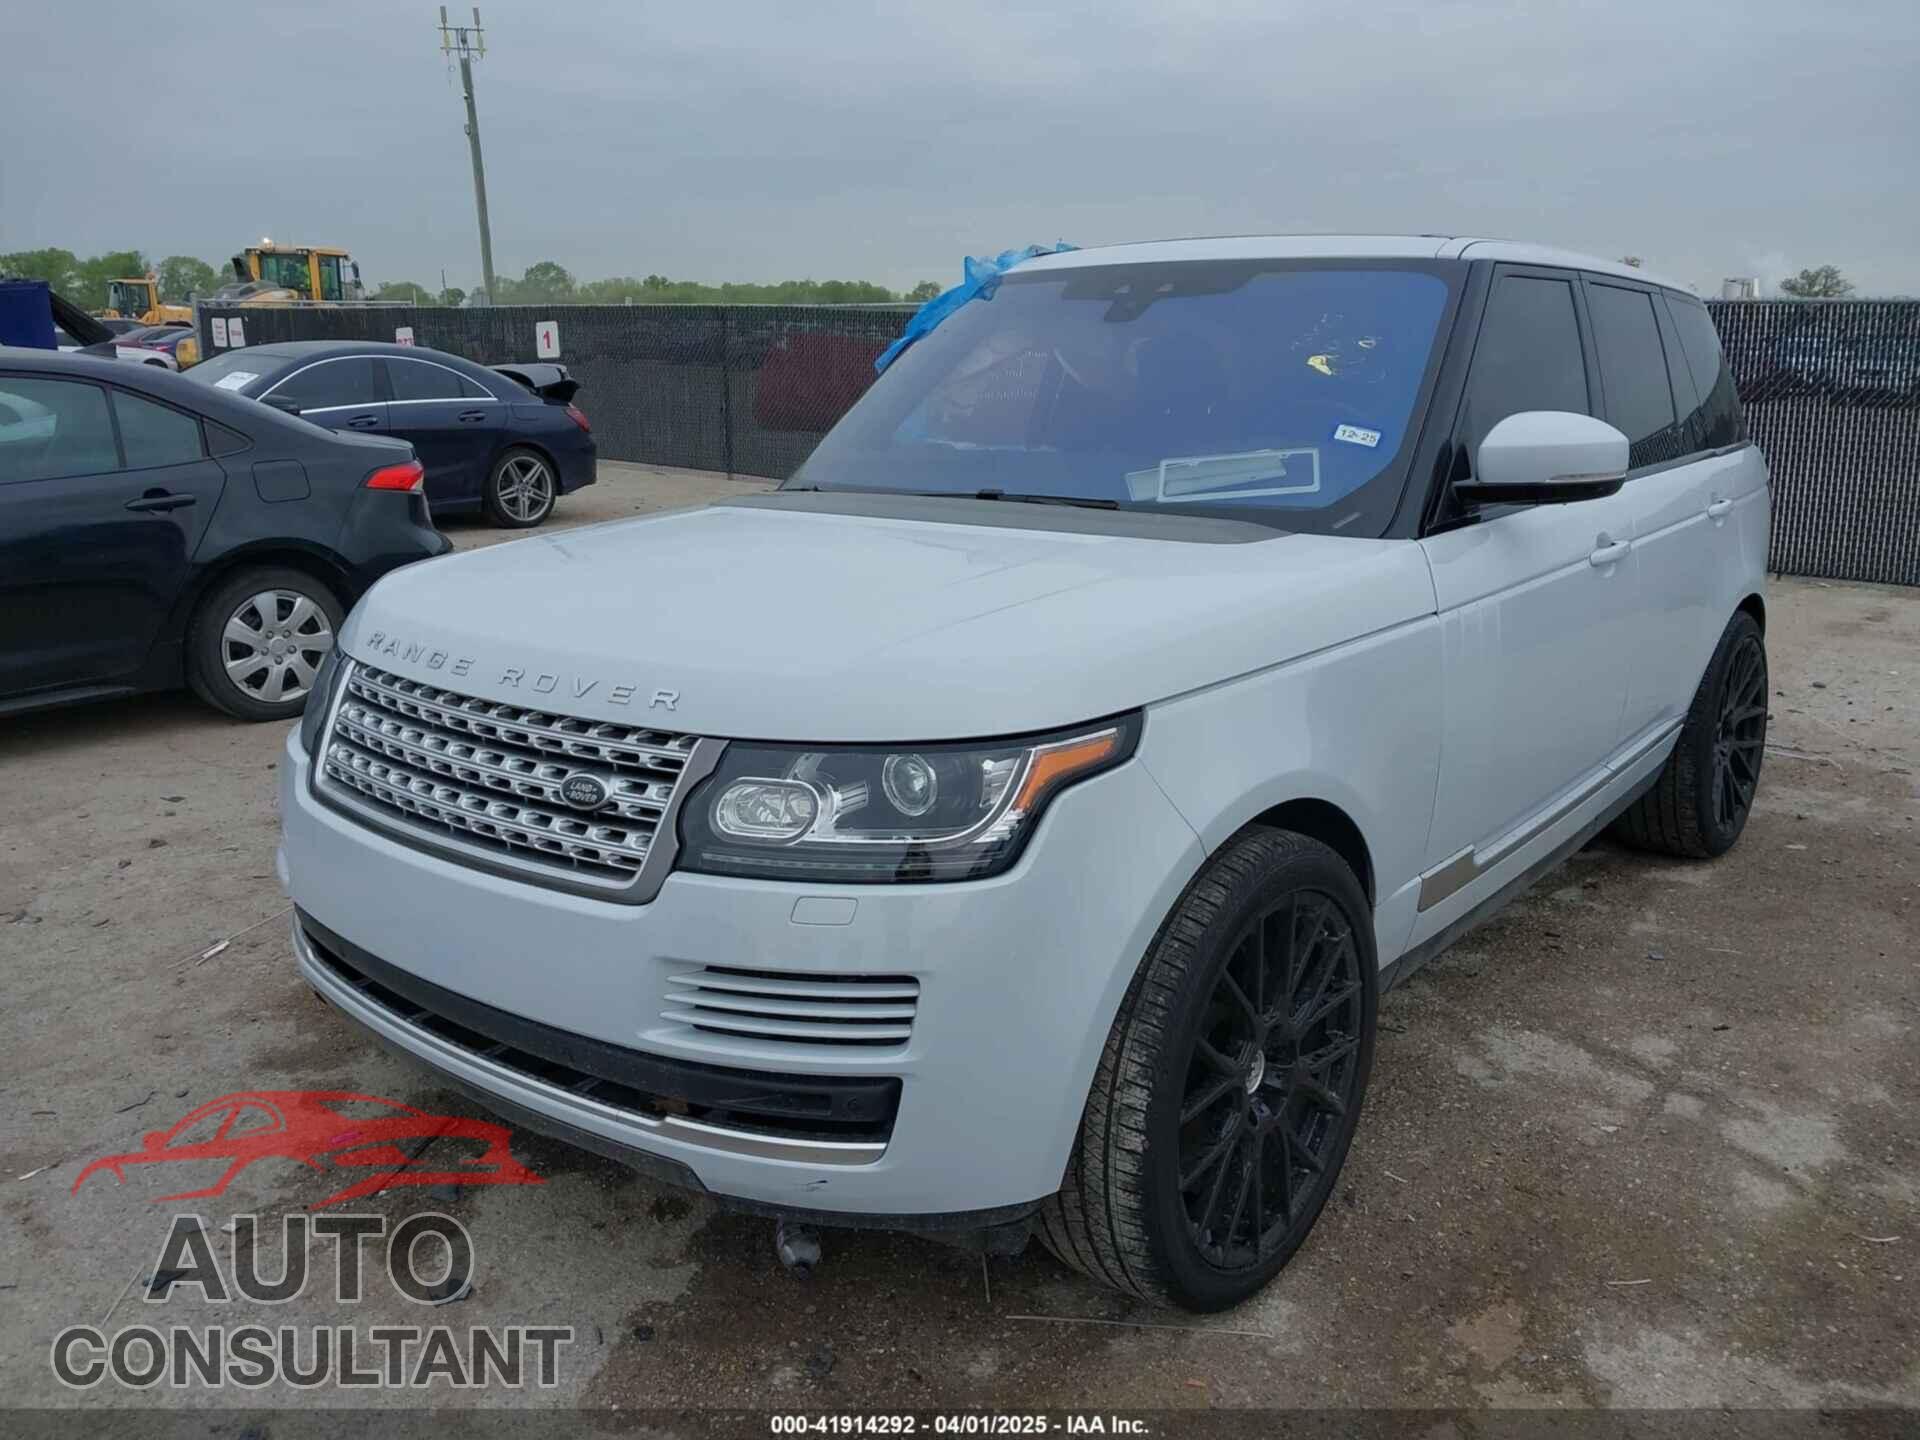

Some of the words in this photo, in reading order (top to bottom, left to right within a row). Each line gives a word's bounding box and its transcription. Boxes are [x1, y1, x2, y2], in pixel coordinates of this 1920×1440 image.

[543, 329, 552, 350] 1
[366, 630, 476, 677] RANGE
[499, 666, 681, 712] ROVER
